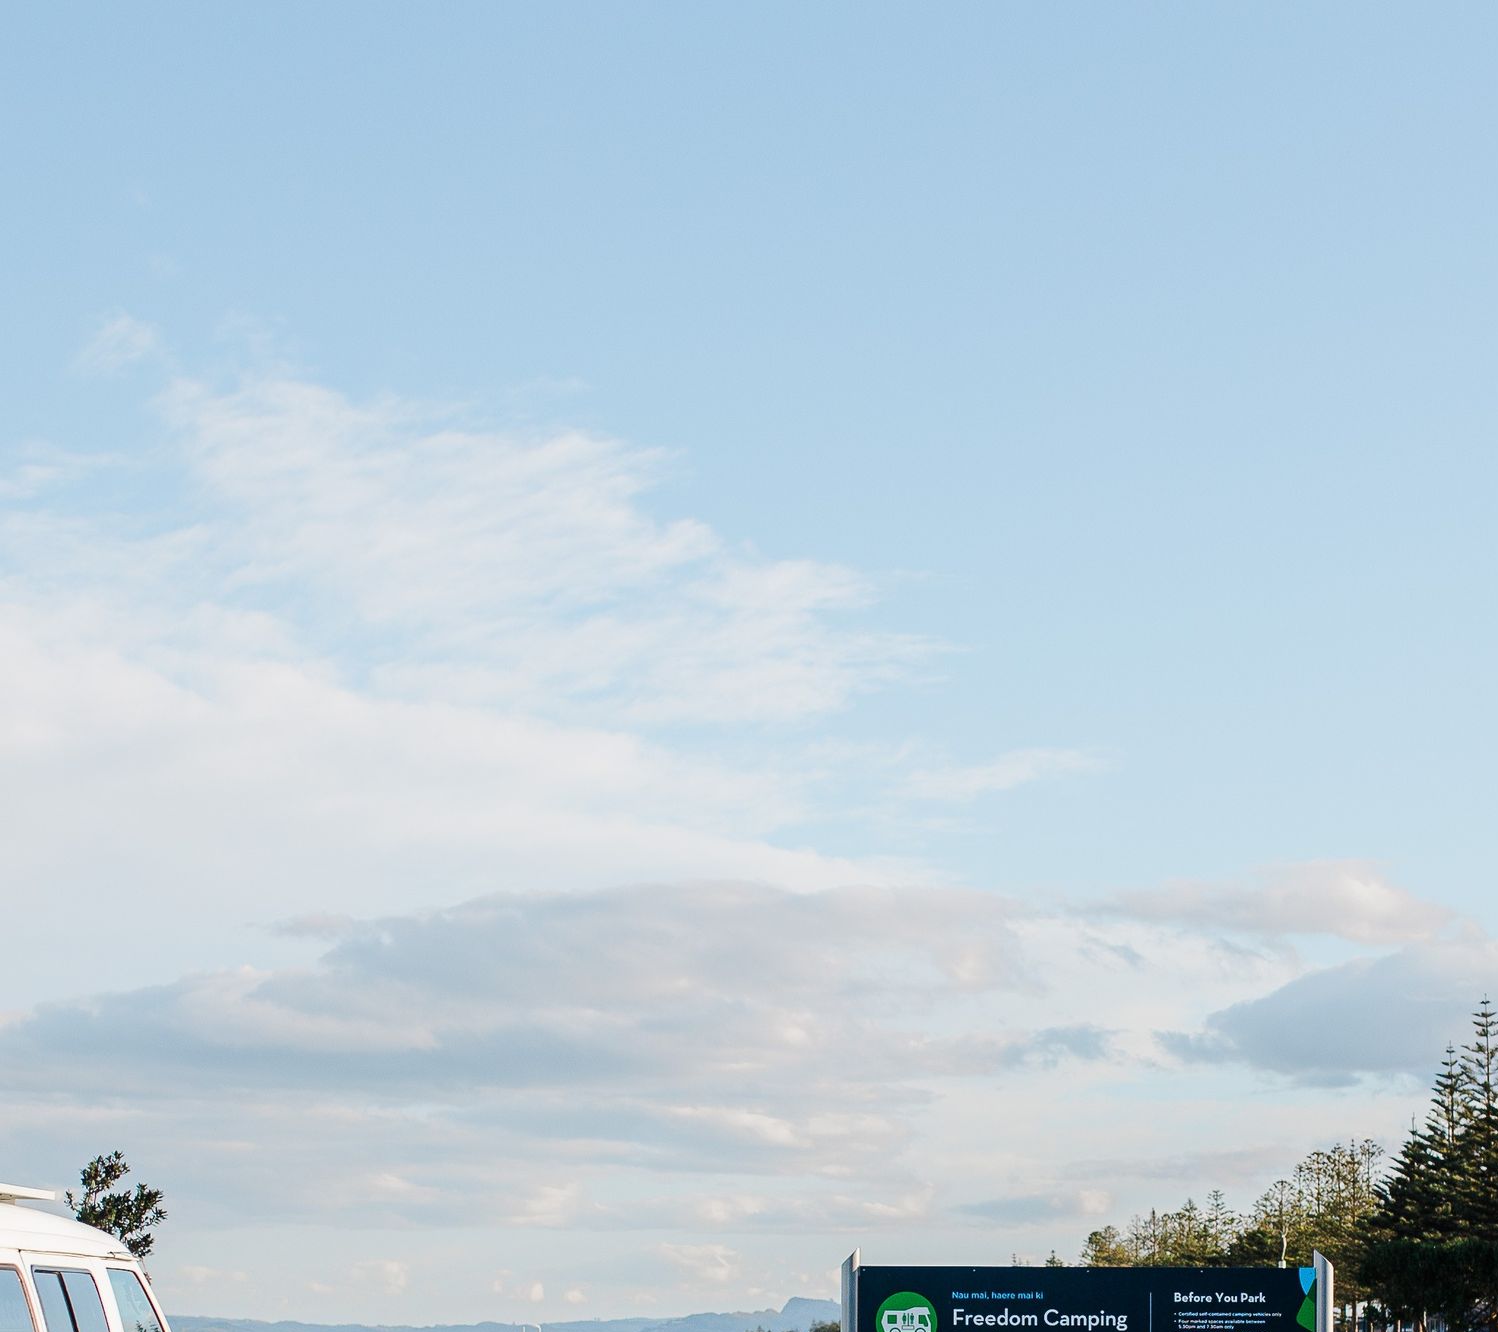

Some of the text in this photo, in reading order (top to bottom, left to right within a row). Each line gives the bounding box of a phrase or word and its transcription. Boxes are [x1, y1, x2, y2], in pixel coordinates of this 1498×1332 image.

[1174, 1291, 1266, 1303] Before You Park
[953, 1308, 1128, 1331] Freedom Camping
